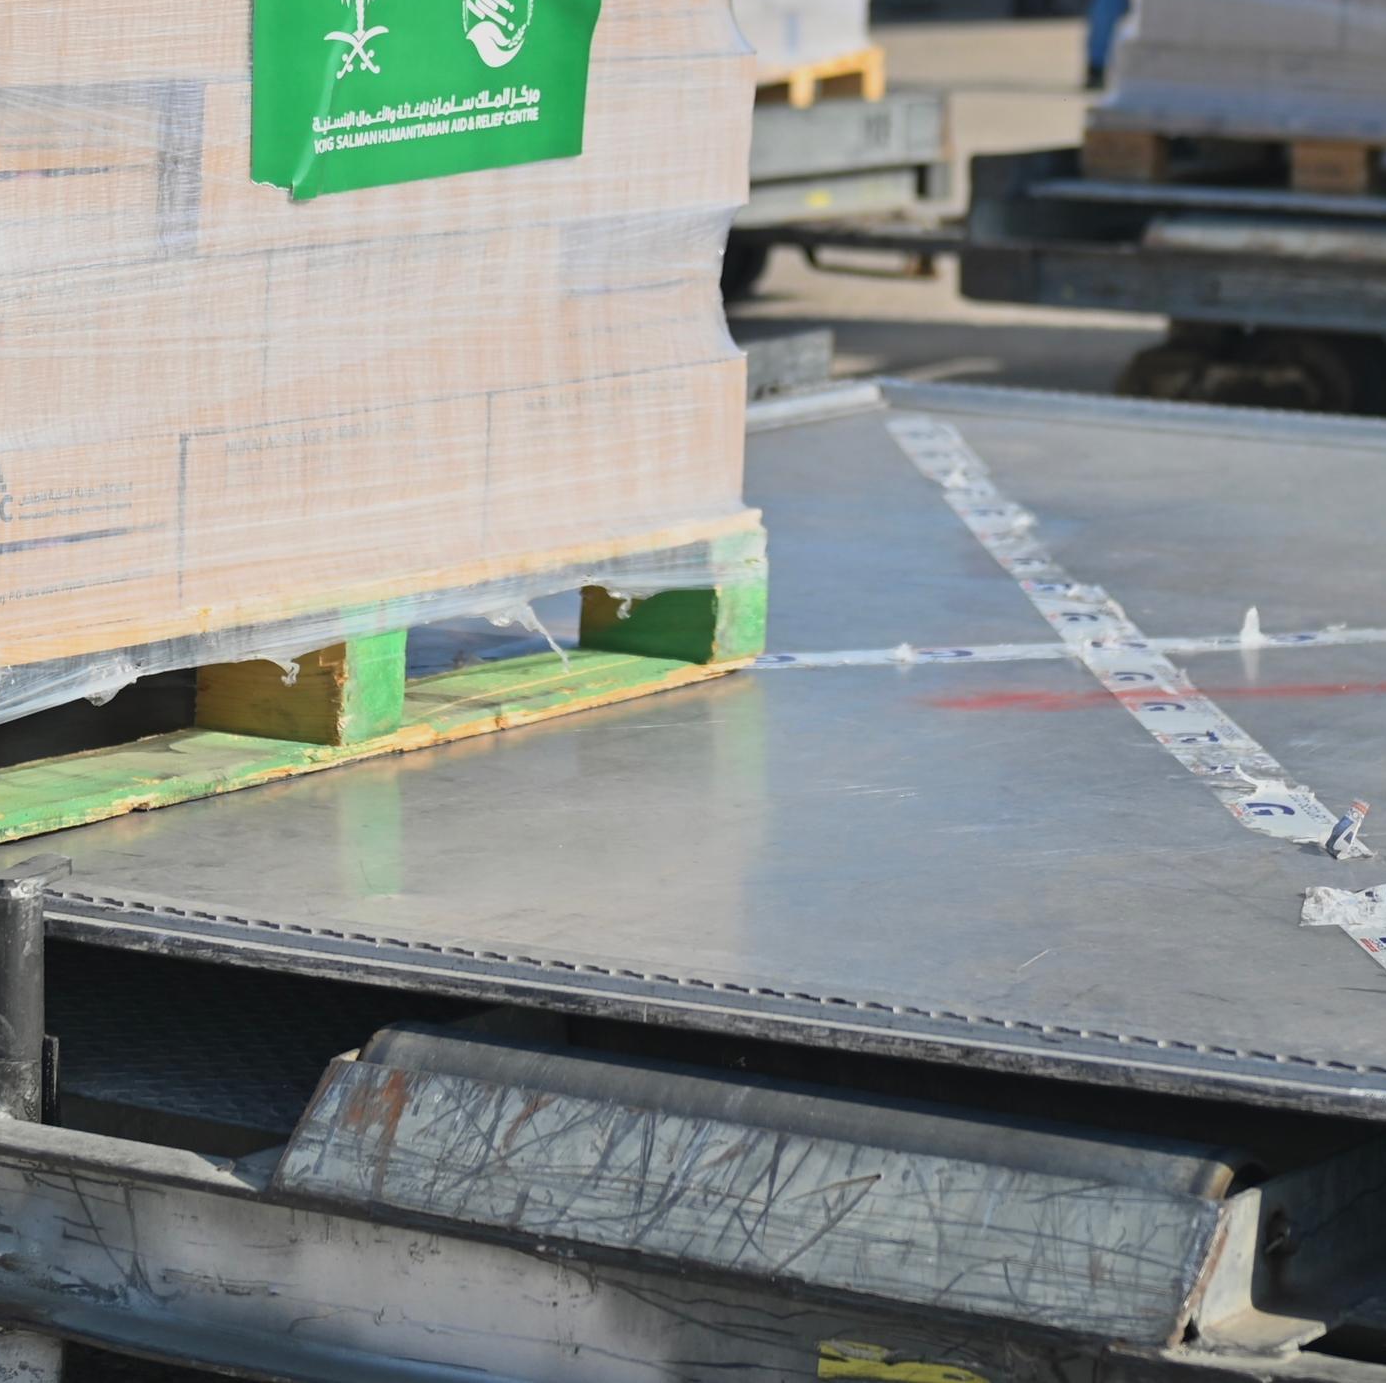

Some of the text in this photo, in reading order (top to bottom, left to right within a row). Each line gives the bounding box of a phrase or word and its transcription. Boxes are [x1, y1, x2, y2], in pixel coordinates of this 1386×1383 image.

[430, 94, 475, 117] سلمان
[476, 88, 510, 109] الملك
[510, 85, 541, 108] مركز
[336, 129, 378, 151] SALMAN
[378, 120, 450, 143] HUMANITARIAN
[451, 118, 467, 133] AID
[468, 117, 476, 131] &
[476, 112, 506, 129] RELIEF
[505, 107, 539, 126] CENTRE
